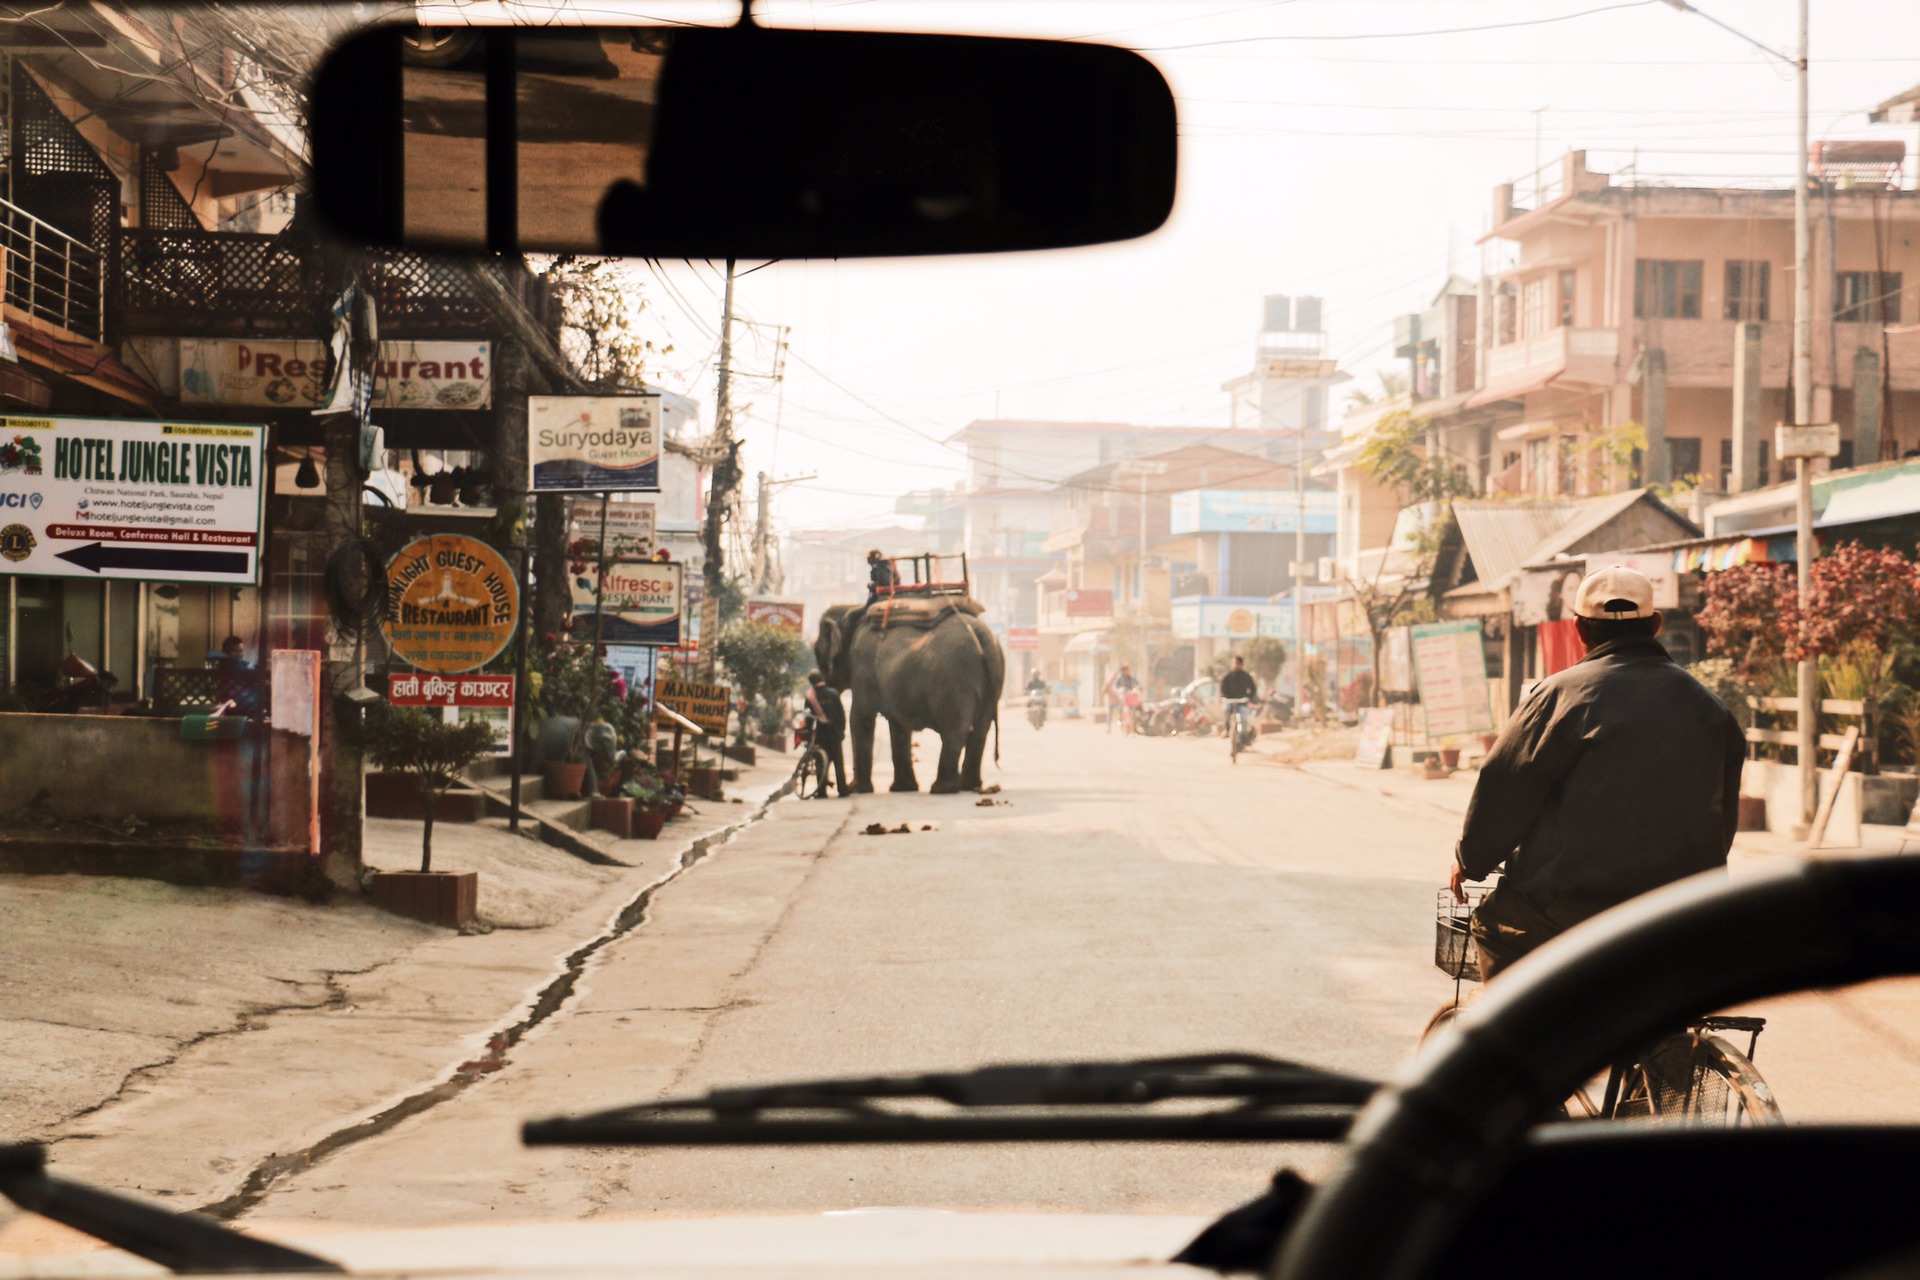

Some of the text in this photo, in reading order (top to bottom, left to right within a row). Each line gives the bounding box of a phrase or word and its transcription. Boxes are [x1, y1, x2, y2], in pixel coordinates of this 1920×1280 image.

[256, 353, 485, 379] Resurant
[538, 428, 652, 450] Suryodaya
[54, 437, 252, 487] HOTEL JUNGLE VISTA
[84, 487, 113, 496] Chitwan
[117, 488, 147, 497] National
[203, 491, 224, 500] Nepal
[93, 499, 215, 512] www.hoteljunglevista.com
[91, 512, 216, 526] hoteljunglevista@gmail.com
[55, 527, 251, 543] Deluxe Room, Conference Hall & Restaurant
[436, 551, 486, 576] GUEST
[483, 572, 511, 624] HOUSE
[402, 602, 490, 626] RESTAURANT
[393, 676, 419, 698] हाती
[461, 681, 511, 698] काउण्टर
[662, 683, 725, 701] MANDALA
[692, 703, 726, 718] HOUSE
